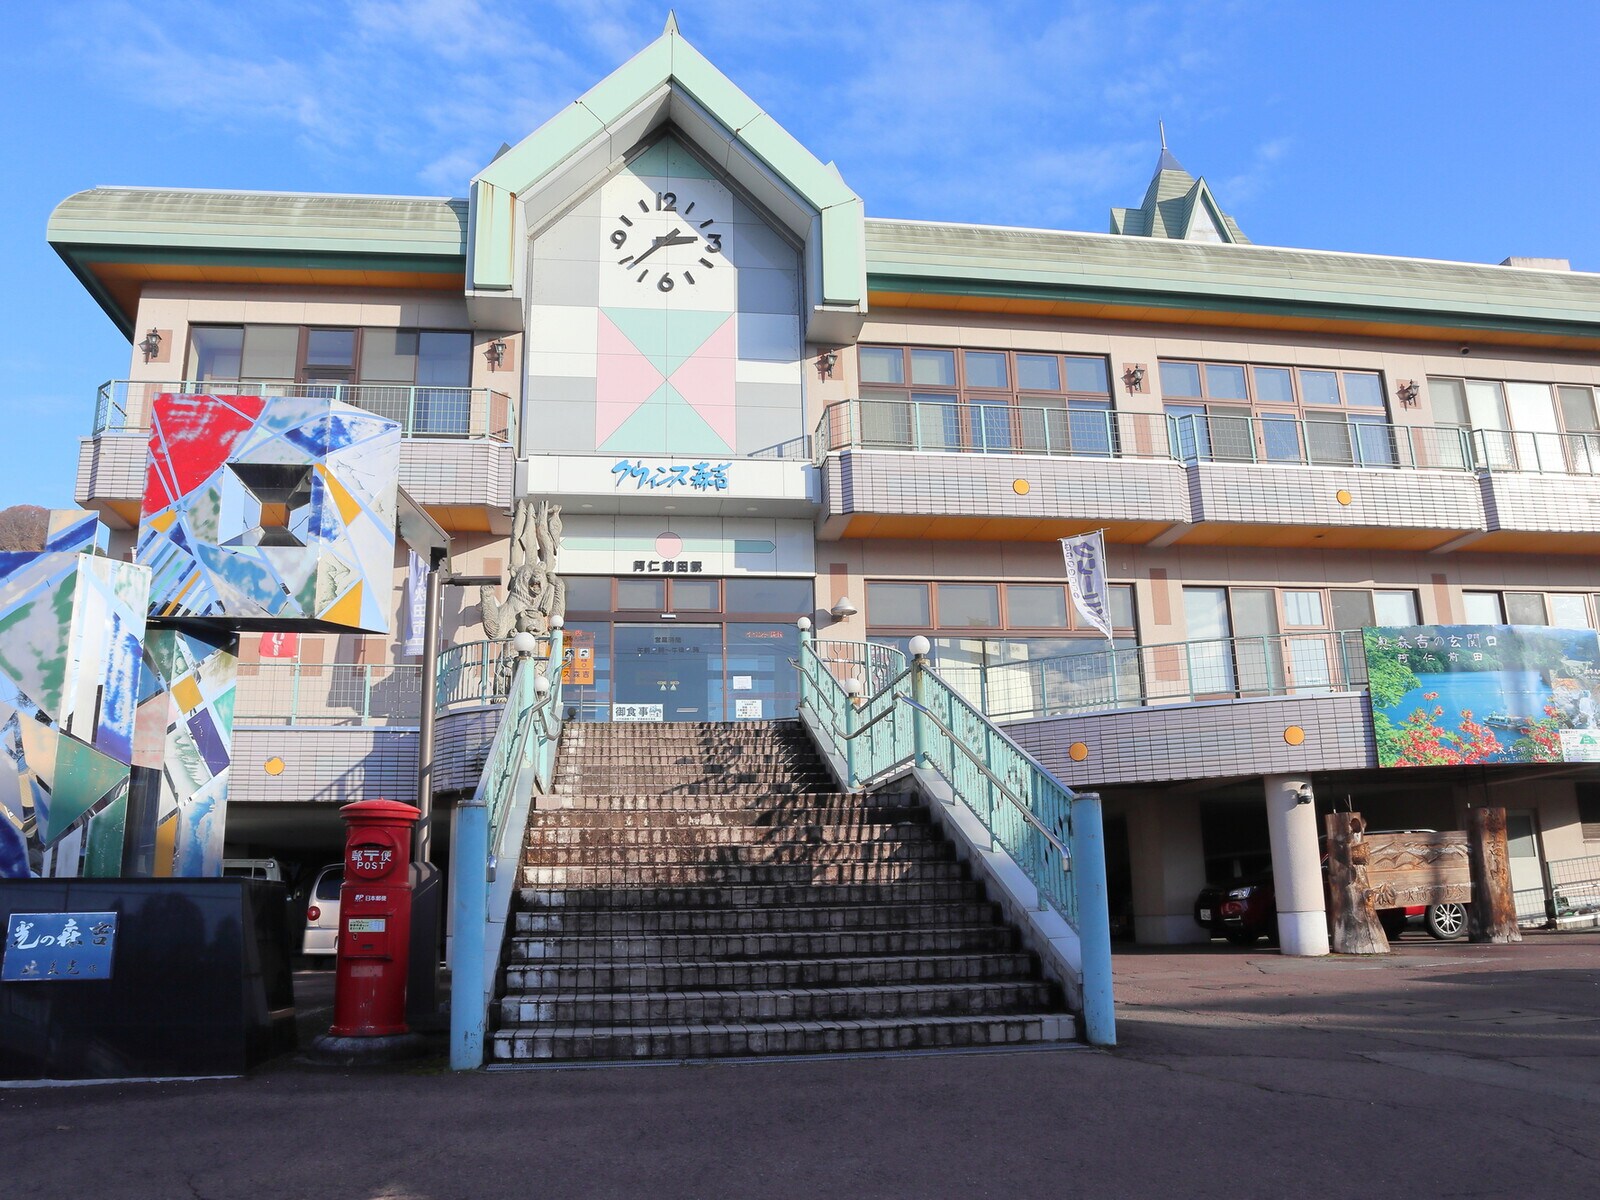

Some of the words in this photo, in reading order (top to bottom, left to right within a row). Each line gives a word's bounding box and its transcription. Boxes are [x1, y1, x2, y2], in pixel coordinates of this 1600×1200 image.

[656, 191, 677, 212] 12
[610, 229, 627, 249] 9
[705, 233, 722, 253] 3
[657, 272, 675, 292] 6
[356, 861, 386, 870] POST
